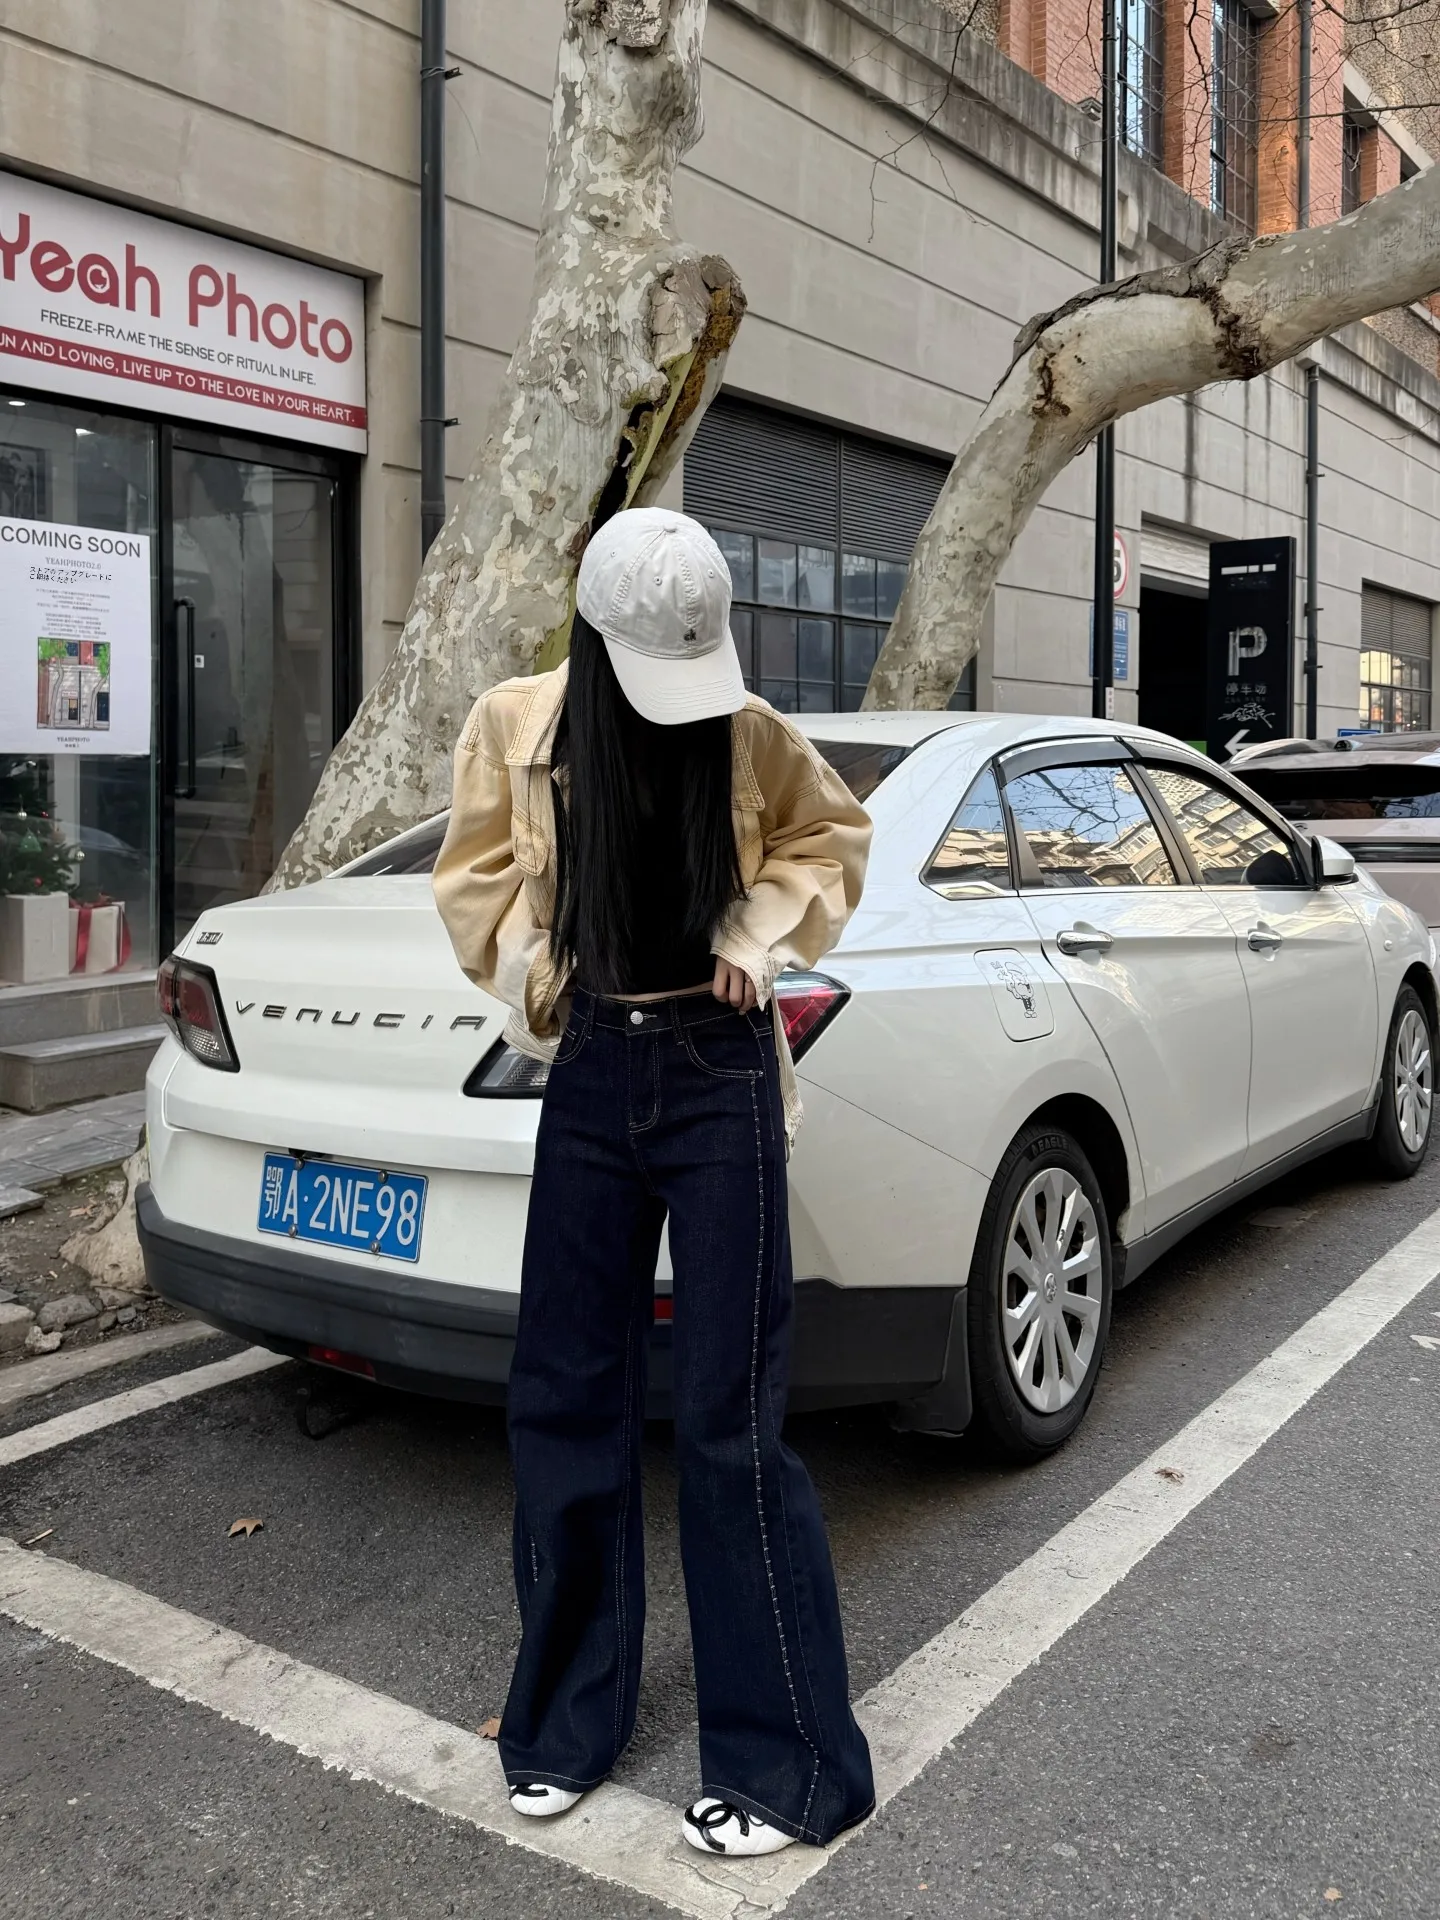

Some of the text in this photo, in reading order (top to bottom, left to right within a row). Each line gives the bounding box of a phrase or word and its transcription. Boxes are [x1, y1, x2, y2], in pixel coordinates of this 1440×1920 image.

[0, 212, 353, 363] Yeah Photo
[41, 309, 316, 385] FREEZE-FRAME THE SENSE OF RITUAL IN LIFE.
[21, 338, 55, 357] AND
[59, 346, 119, 373] LOVING,
[122, 360, 152, 378] LIVE
[155, 367, 172, 382] UP
[176, 372, 196, 387] TO
[199, 377, 224, 394] THE
[227, 383, 260, 402] LOVE
[262, 391, 275, 405] IN
[277, 394, 310, 413] YOUR
[312, 402, 355, 422] HEART.
[1, 525, 141, 558] COMING SOON
[1228, 626, 1268, 676] P
[235, 1000, 488, 1031] VENUCIA
